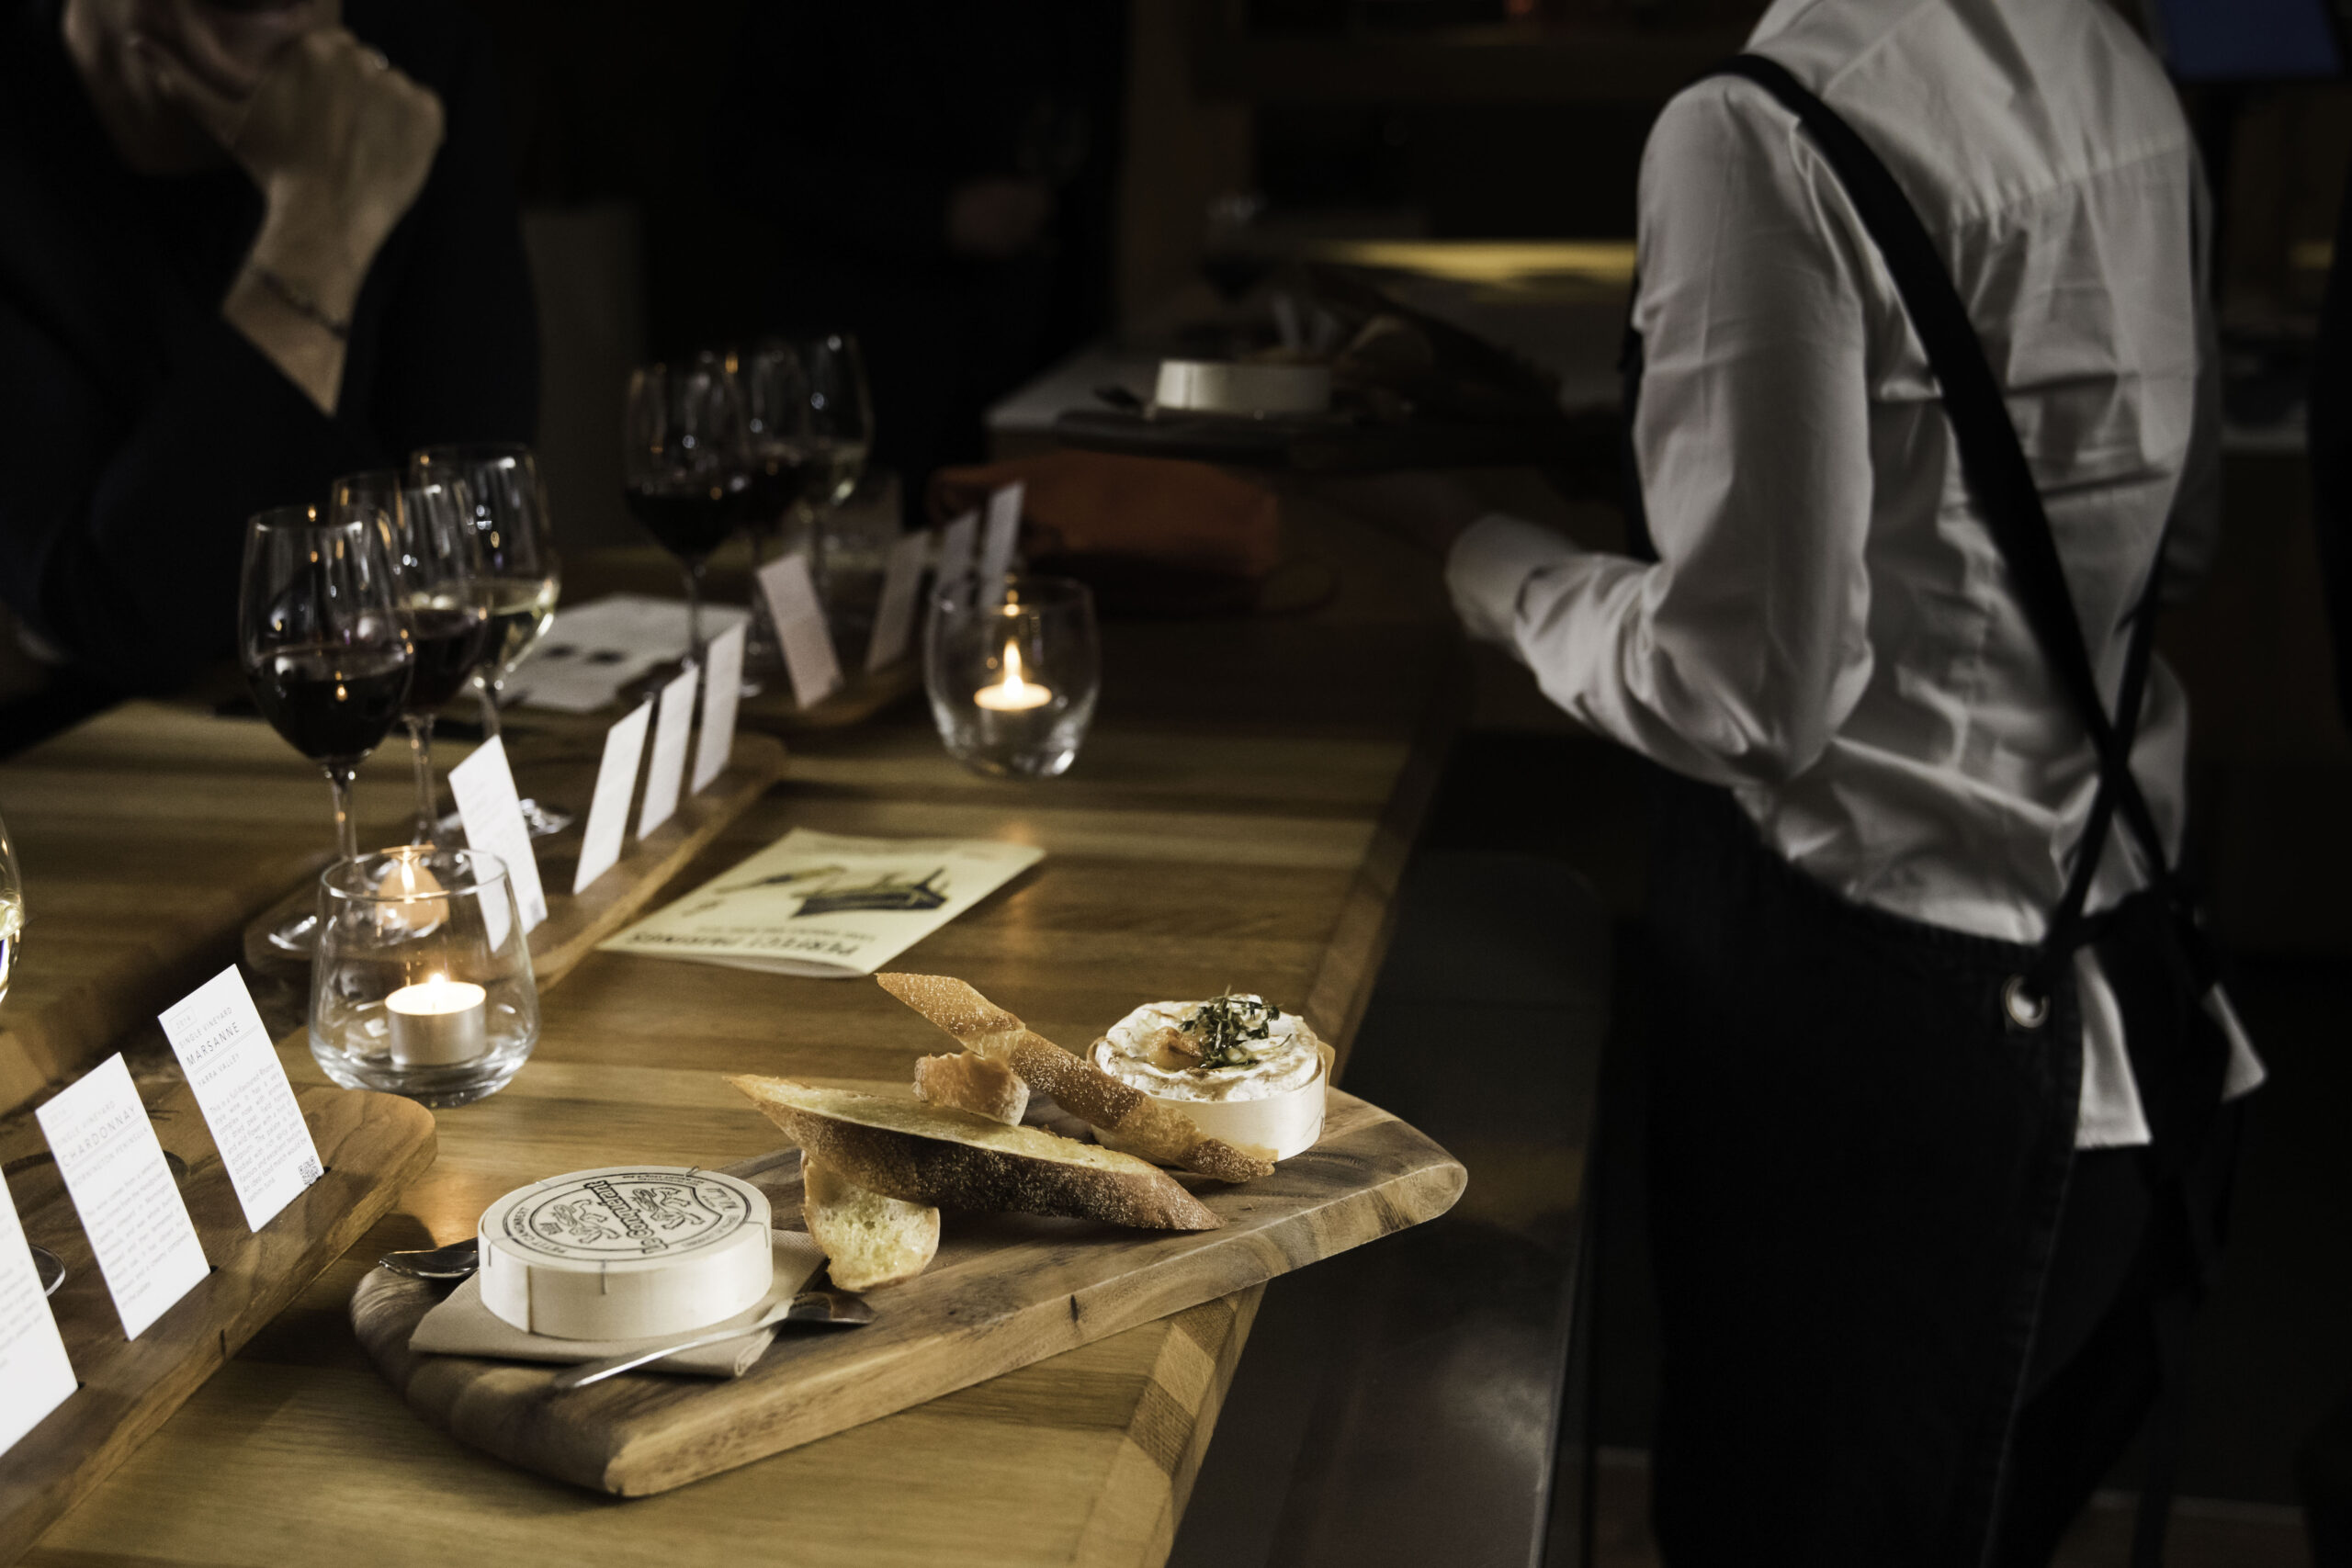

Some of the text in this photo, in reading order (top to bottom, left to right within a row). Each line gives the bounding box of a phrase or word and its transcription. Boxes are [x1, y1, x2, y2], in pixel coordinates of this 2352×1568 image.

[178, 1006, 232, 1049] SINGLE VINEYARD
[186, 1021, 239, 1066] MARSANNE
[198, 1052, 240, 1087] YARRA VALLEY
[61, 1103, 137, 1168] CHARDONNAY
[512, 1206, 535, 1241] CAMEMBERT
[583, 1179, 669, 1254] Le Conquérant
